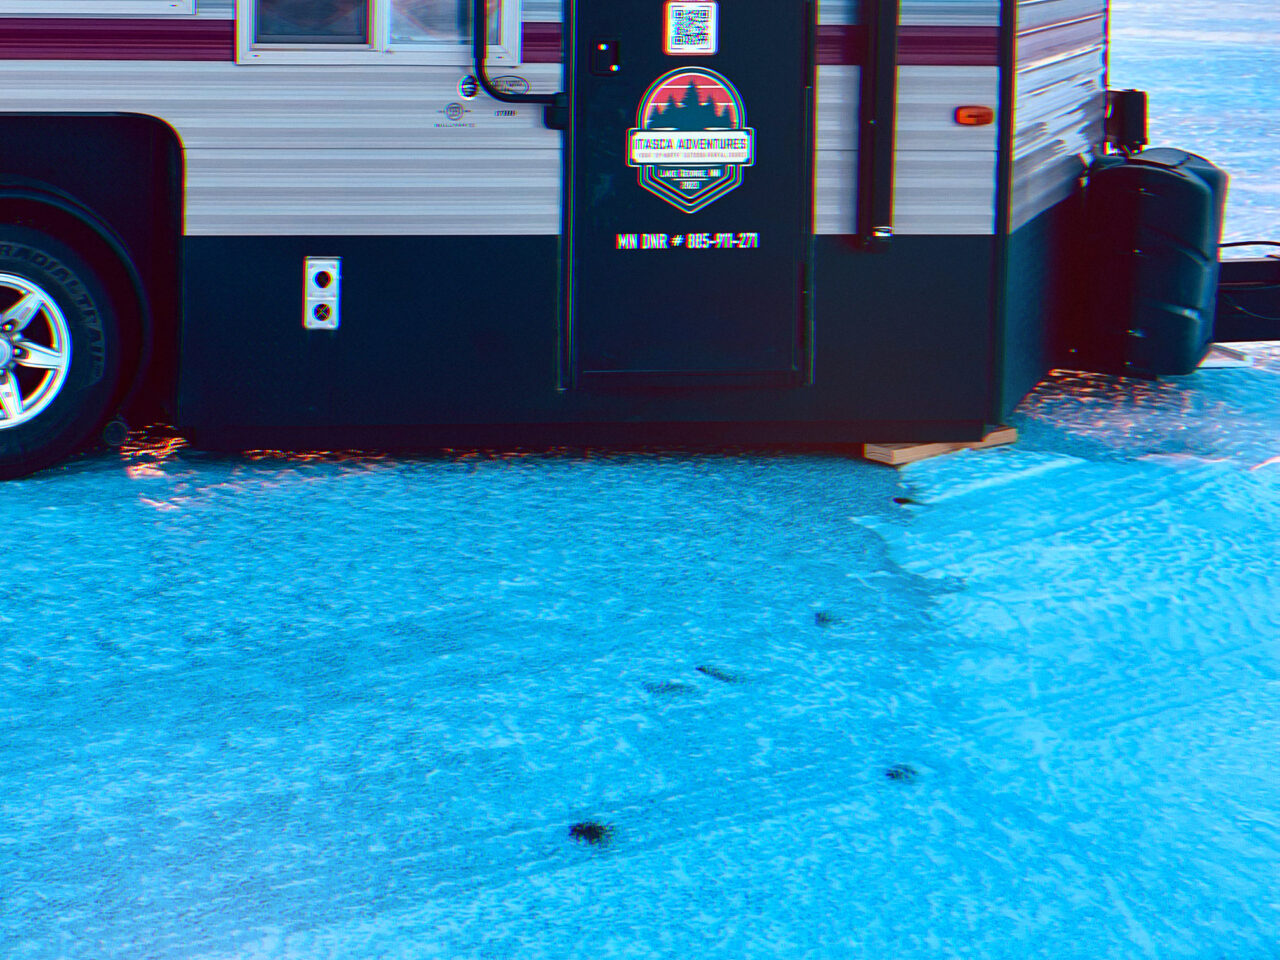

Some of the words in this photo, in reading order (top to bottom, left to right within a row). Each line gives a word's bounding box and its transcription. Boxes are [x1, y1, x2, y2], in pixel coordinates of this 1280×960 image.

[635, 138, 674, 150] ITASCA
[678, 138, 747, 150] ADVENTURES
[660, 169, 678, 177] LAKE
[710, 169, 721, 177] MN
[682, 181, 700, 189] 2023
[618, 233, 638, 249] MN
[642, 233, 668, 249] DNR
[671, 234, 684, 246] #
[687, 232, 758, 249] 885-911-271
[75, 292, 103, 369] TRAIL
